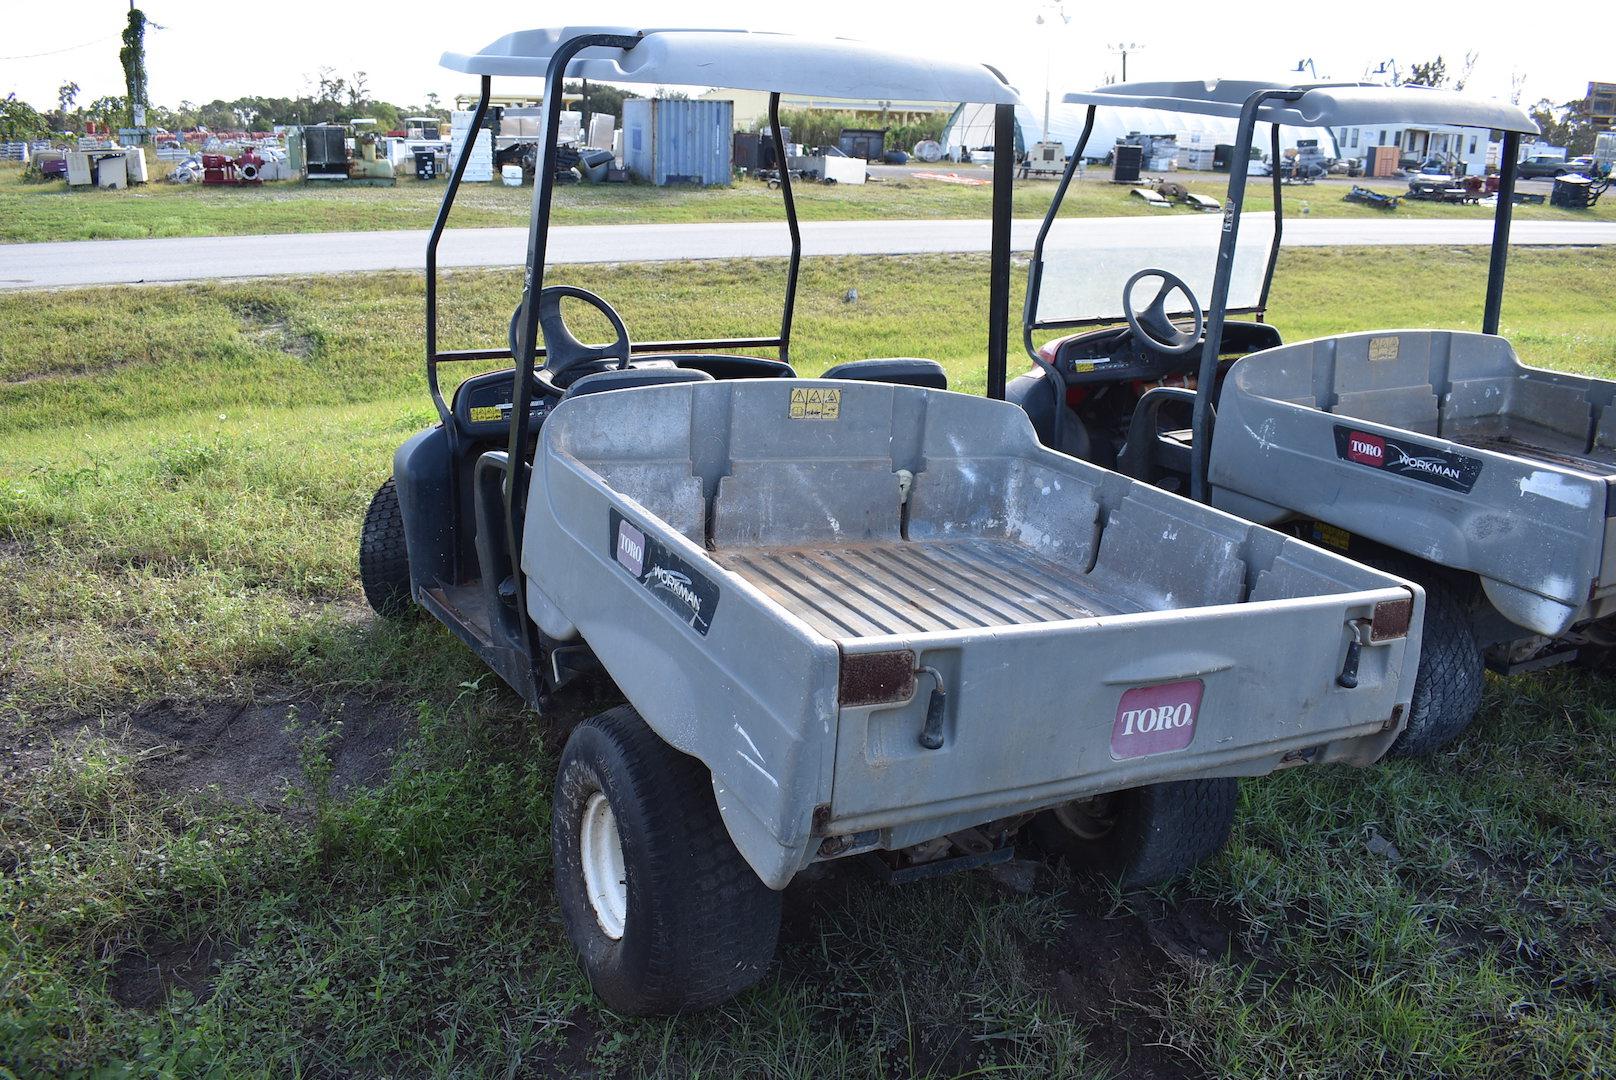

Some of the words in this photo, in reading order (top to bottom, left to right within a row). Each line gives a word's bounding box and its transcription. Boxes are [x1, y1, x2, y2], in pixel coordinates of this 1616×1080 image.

[1351, 440, 1382, 458] TORO
[1399, 454, 1460, 479] WORKMAN
[620, 533, 642, 562] TORO
[653, 563, 702, 611] WORKMAN
[1121, 702, 1192, 736] TORO
